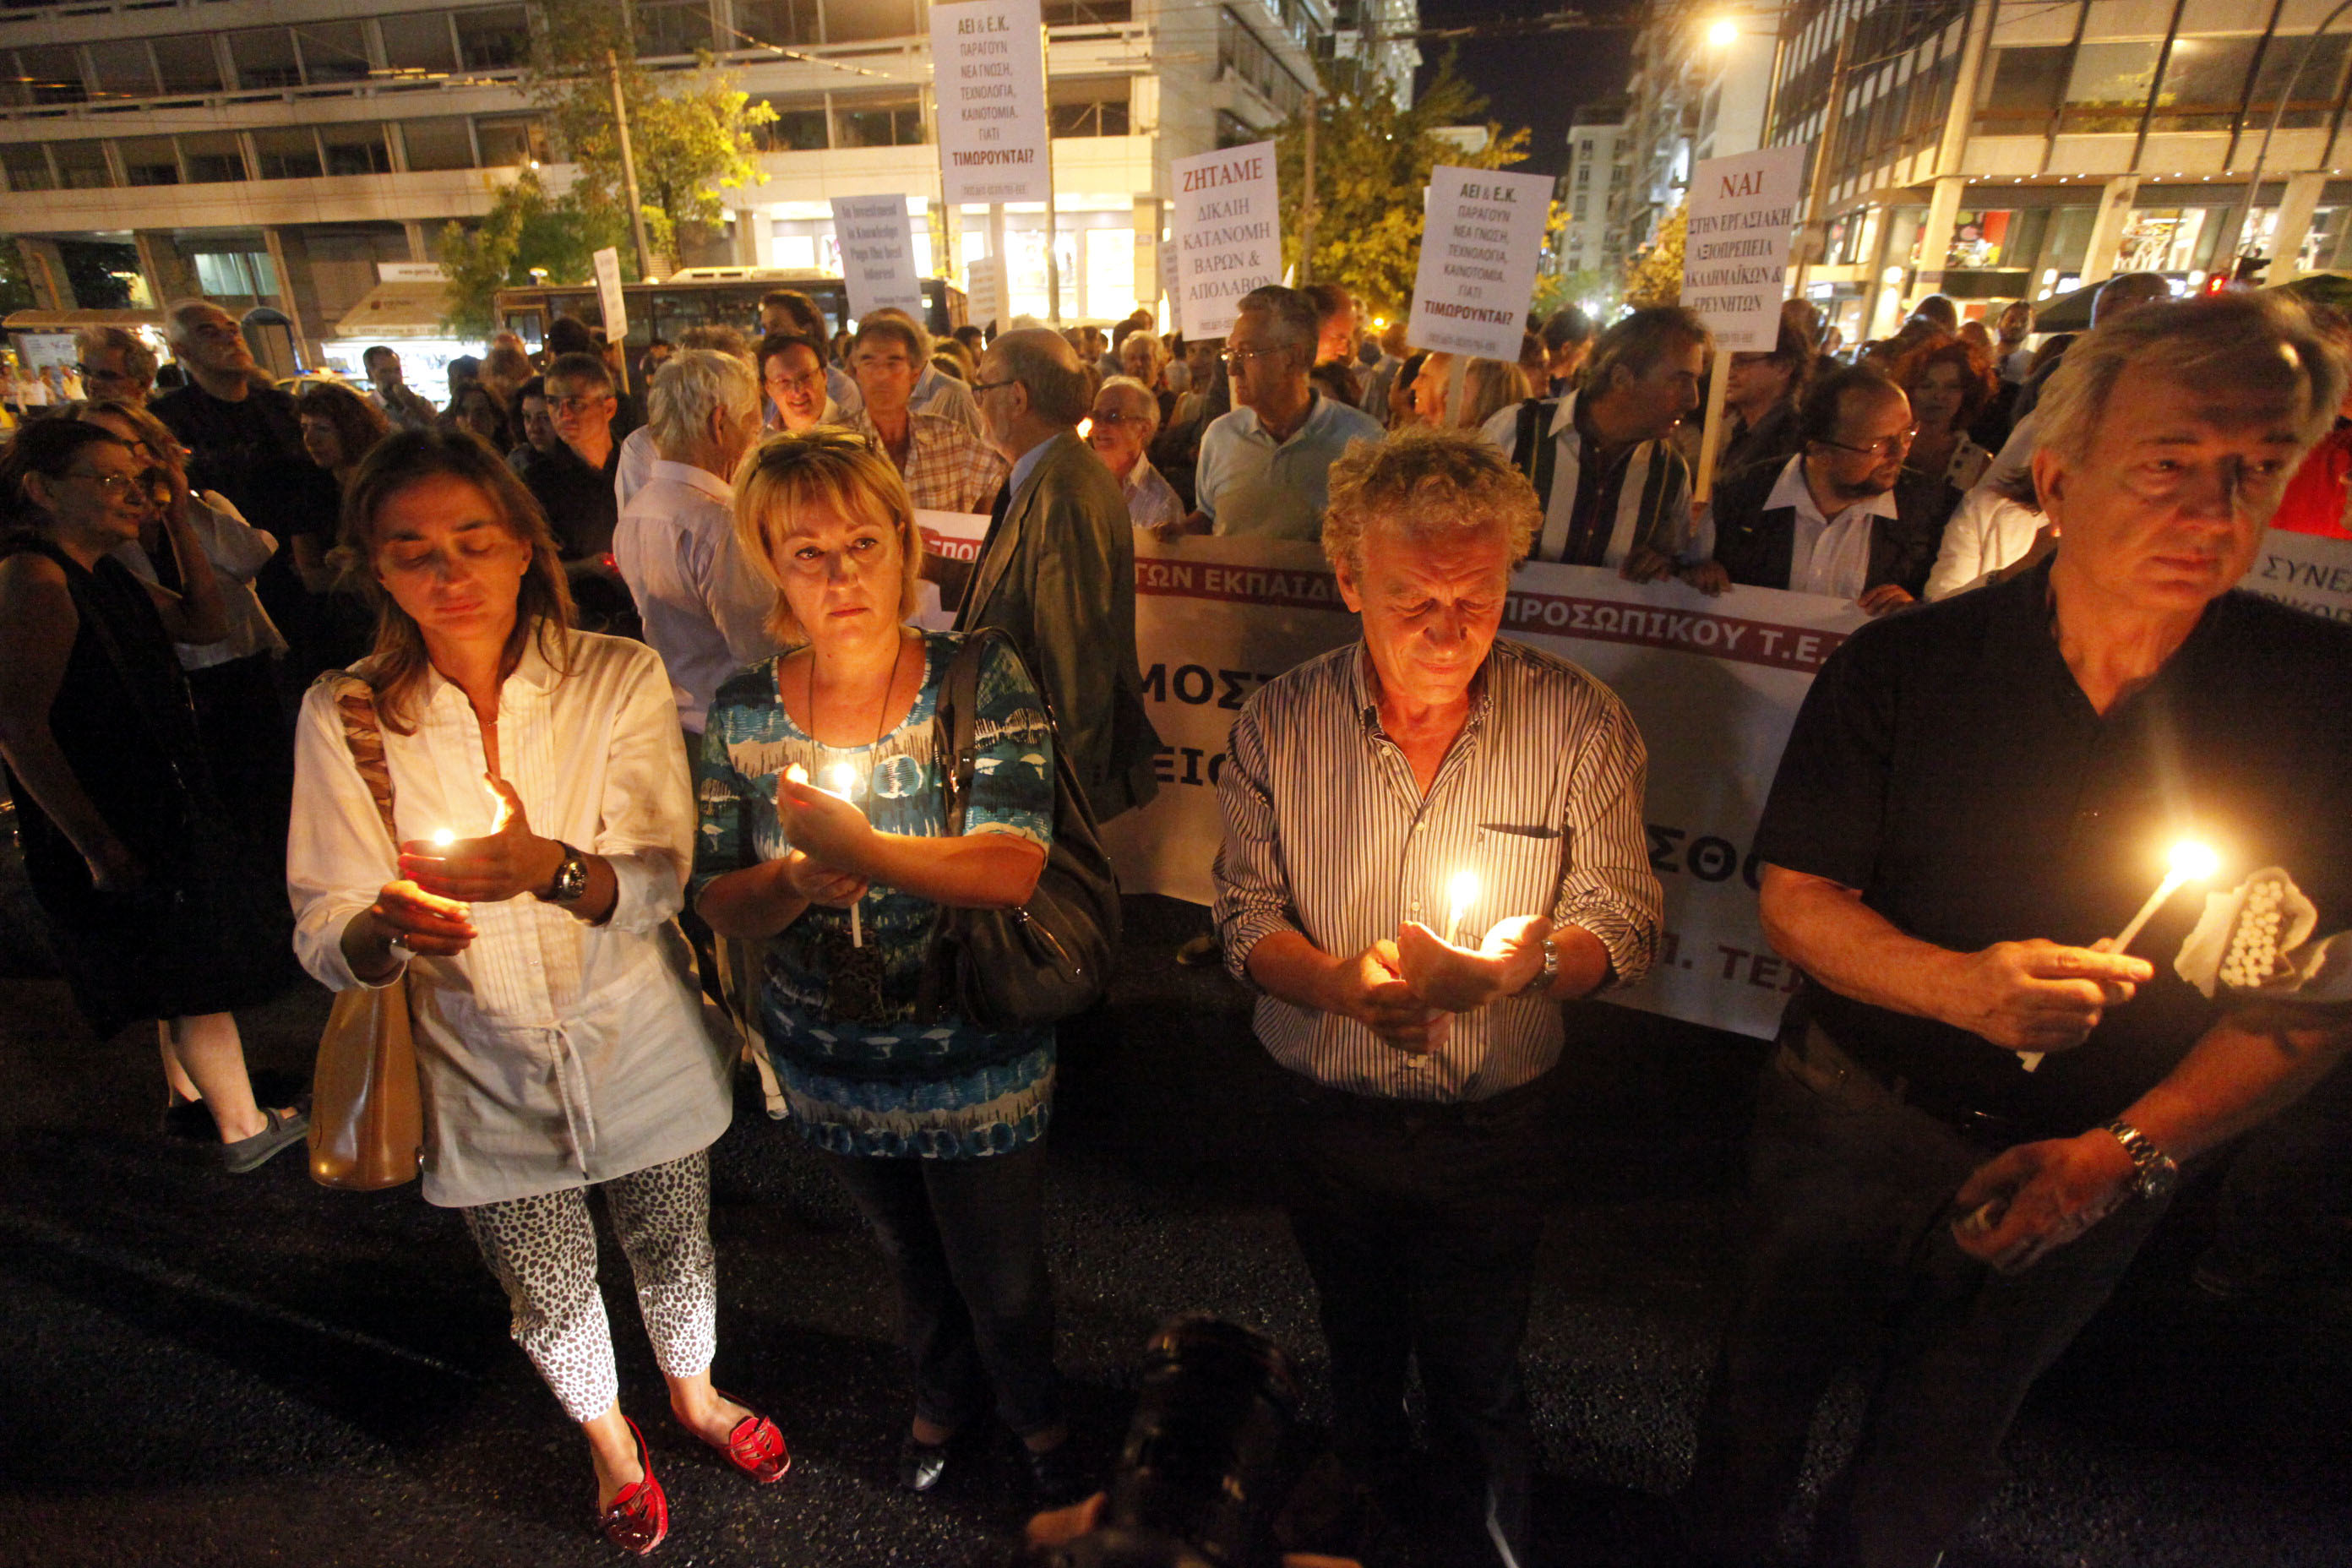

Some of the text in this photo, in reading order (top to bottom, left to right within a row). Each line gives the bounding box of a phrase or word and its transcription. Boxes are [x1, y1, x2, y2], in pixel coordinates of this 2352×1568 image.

[958, 16, 1010, 35] ΑΕΙ & Ε.Κ.
[960, 41, 1008, 57] ΠΑΡΑΓΟΥΝ
[961, 64, 979, 79] ΝΕΑ
[979, 128, 1000, 141] ΓΙΑΤΙ
[952, 149, 1034, 166] ΤΙΜΩΡΟΥΝΤΑΙ?
[1183, 157, 1264, 193] ΖΗΤΑΜΕ
[1460, 183, 1480, 199] ΑΕΙ
[1483, 187, 1490, 200] &
[1719, 170, 1764, 199] ΝΑΙ
[1197, 197, 1250, 222] ΔΙΚΑΙΗ
[1458, 205, 1511, 222] ΠΑΡΑΓΟΥΝ
[1689, 208, 1791, 235] ΣΤΗΝ ΕΡΓΑΣΙΑΚΗ
[1184, 222, 1271, 251] ΚΑΤΑΝΟΜΗ
[1453, 225, 1473, 238] ΝΕΑ
[1696, 239, 1772, 260] ΑΞΙΟΠΡΕΠΕΙΑ
[1195, 250, 1261, 275] ΒΑΡΩΝ &
[1771, 266, 1782, 283] &
[1459, 284, 1482, 298] ΓΙΑΤΙ
[1424, 300, 1514, 325] ΤΙΜΩΡΟΥΝΤΑΙ?
[1691, 295, 1762, 313] ΕΡΕΥΝΗΤΩΝ
